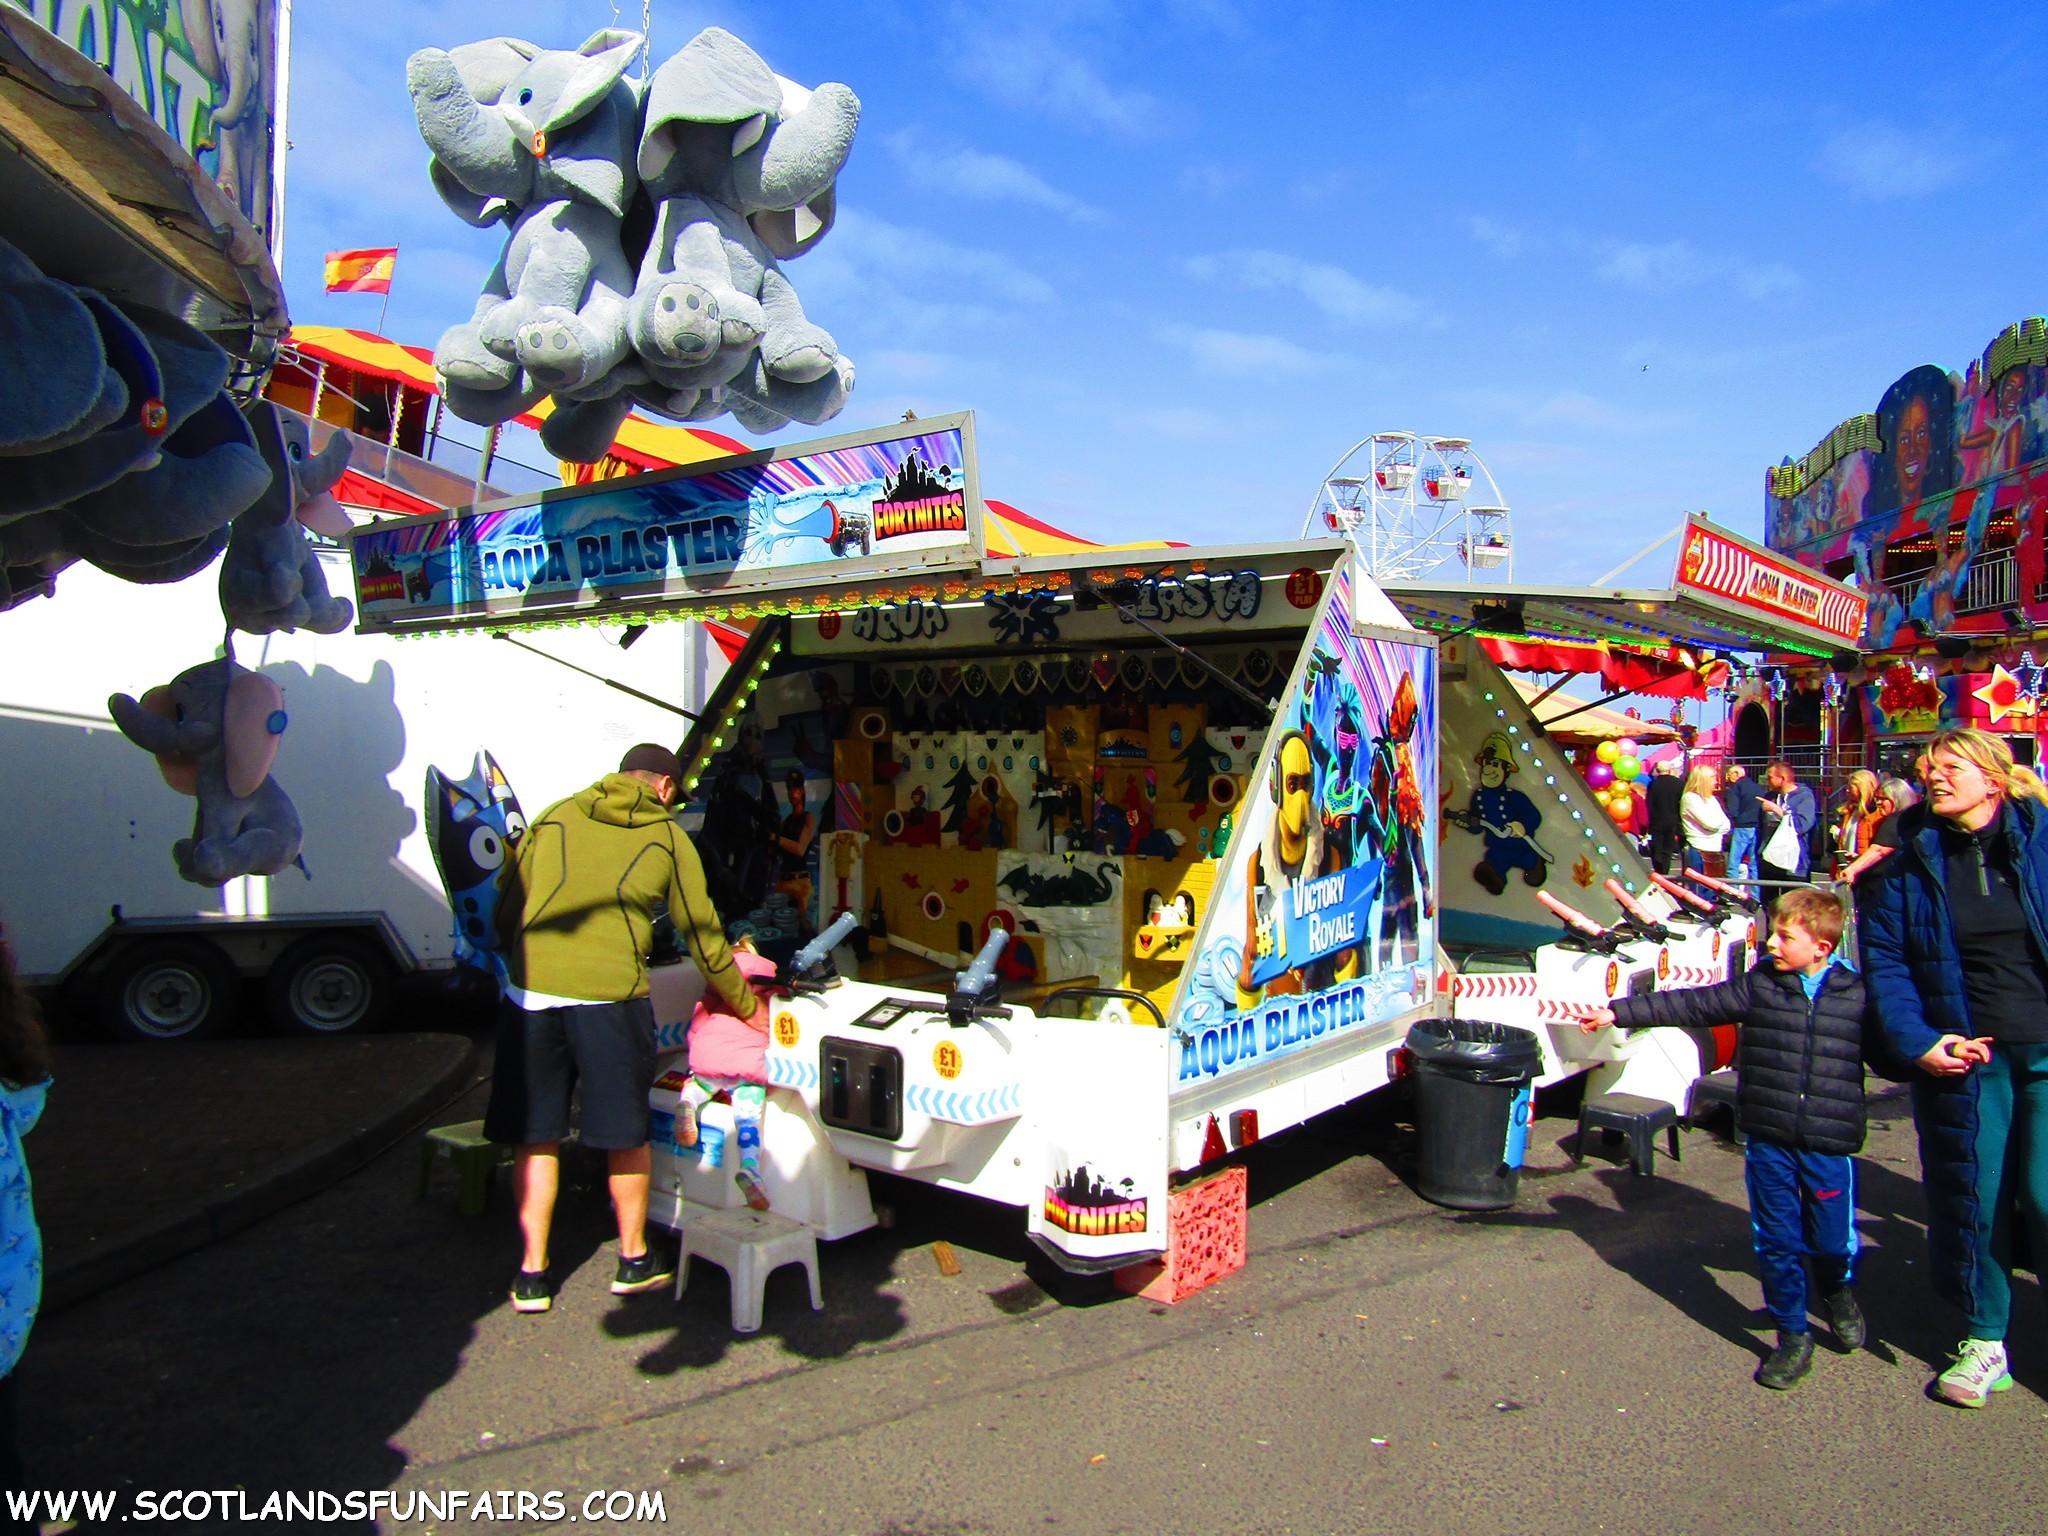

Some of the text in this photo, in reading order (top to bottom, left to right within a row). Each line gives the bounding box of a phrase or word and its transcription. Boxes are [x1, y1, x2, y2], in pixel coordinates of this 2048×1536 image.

[874, 492, 964, 539] FORTNITES
[483, 515, 741, 593] AQUA BLASTER
[1294, 575, 1314, 595] £1
[1295, 595, 1312, 605] PLAY
[1750, 569, 1819, 616] AQUA BLASTER
[1292, 874, 1346, 919] VICTORY
[1255, 893, 1287, 959] #1
[1309, 912, 1355, 954] ROYALE
[780, 1017, 794, 1035] £1
[1179, 986, 1366, 1080] AQUA BLASTER
[940, 1047, 956, 1068] £1
[940, 1067, 955, 1079] PLAY
[1046, 1187, 1146, 1236] FORTNITES
